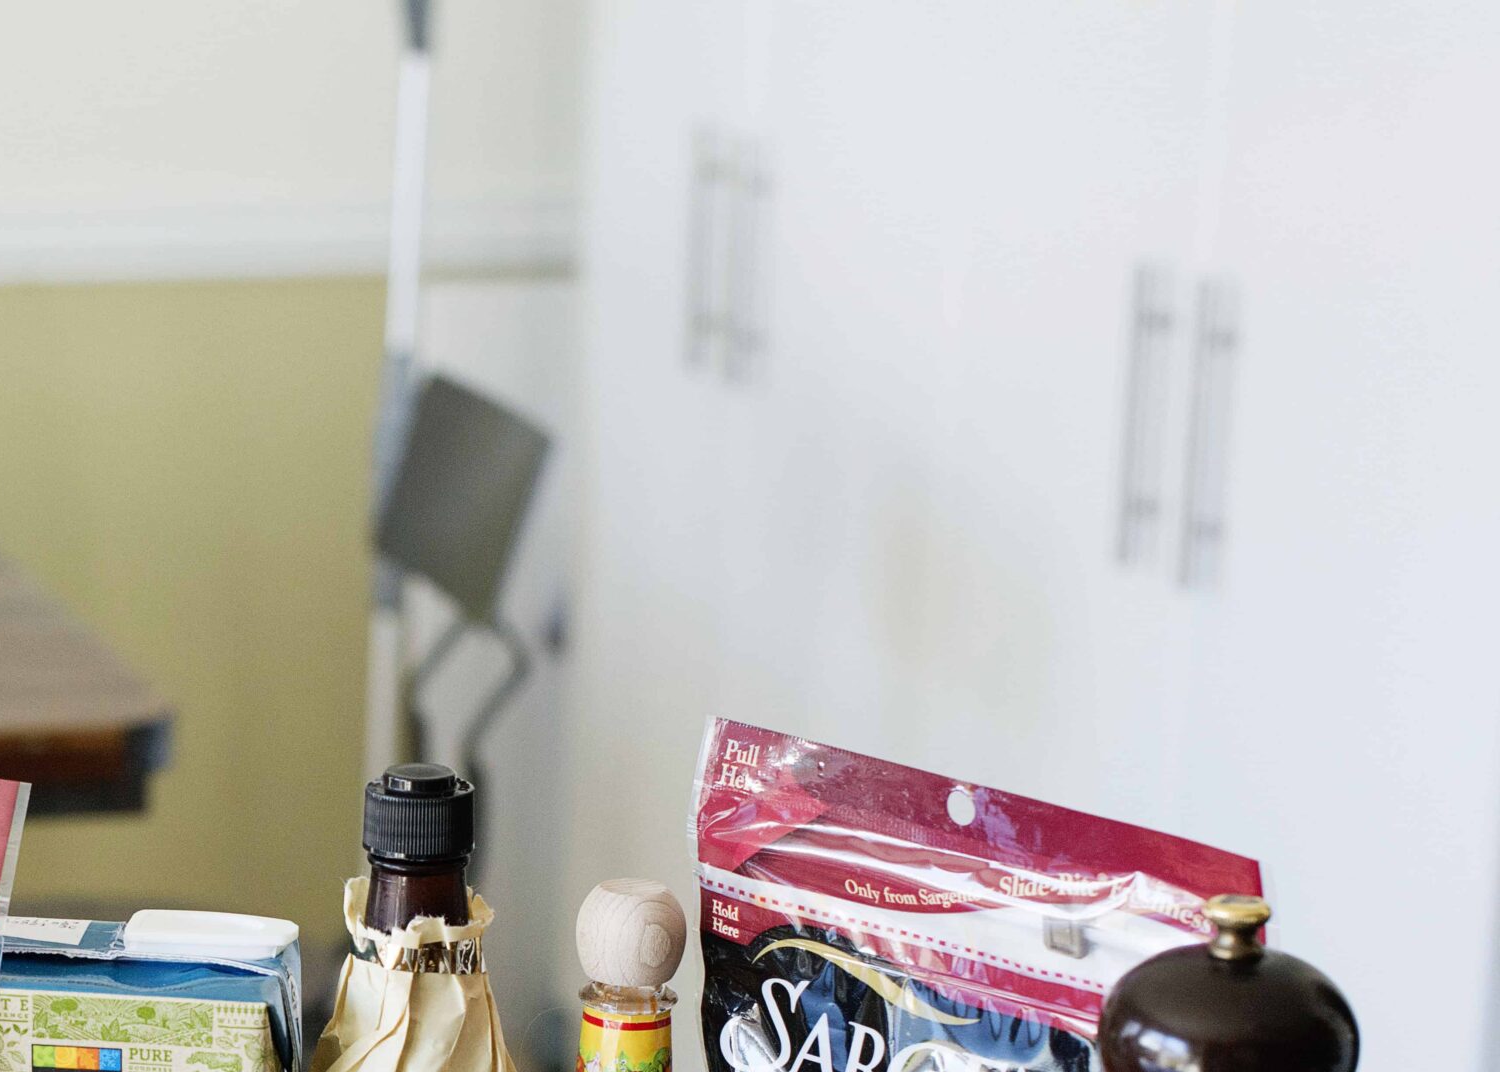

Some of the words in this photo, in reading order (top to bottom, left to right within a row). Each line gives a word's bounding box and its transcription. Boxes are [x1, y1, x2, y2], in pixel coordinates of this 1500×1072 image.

[724, 738, 760, 767] Pull
[844, 879, 880, 904] Only
[883, 886, 917, 905] from
[712, 898, 740, 921] Hold
[712, 917, 740, 939] Here
[128, 1047, 173, 1063] PURE
